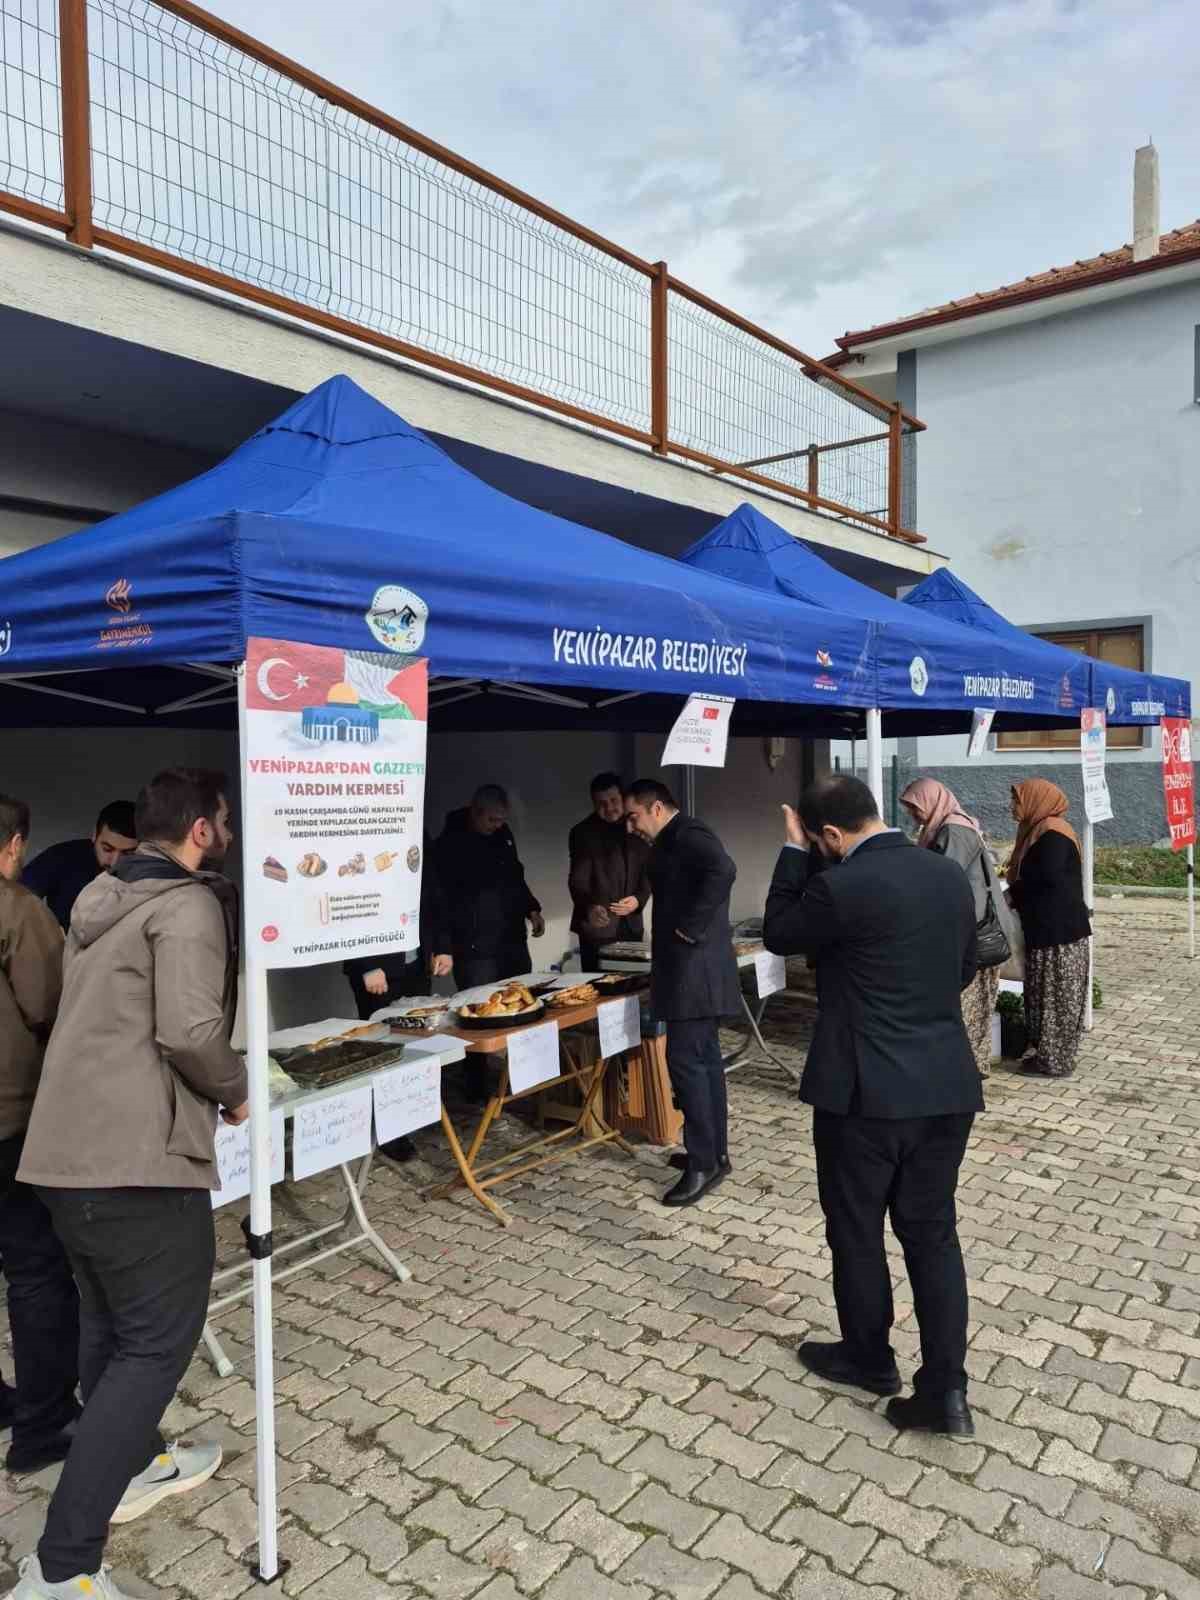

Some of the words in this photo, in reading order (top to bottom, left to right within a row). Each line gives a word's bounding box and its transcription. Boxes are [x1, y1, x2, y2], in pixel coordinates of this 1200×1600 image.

[553, 625, 657, 671] YENİPAZAR
[662, 638, 747, 677] BELEDİYESİ
[963, 673, 1000, 698] YENİPAZAR
[1001, 675, 1034, 699] BELEDİYESİ
[249, 756, 370, 774] YENİPAZAR'DAN
[287, 783, 344, 796] YARDIM
[346, 780, 404, 796] KERMESİ
[284, 808, 307, 816] KASIM
[309, 807, 348, 816] ÇARŞAMBA
[349, 806, 370, 814] GÜNÜ
[287, 818, 318, 827] YERİNDE
[320, 818, 358, 826] YAPILACAK
[359, 817, 377, 825] OLAN
[293, 941, 339, 955] YENİPAZAR
[341, 938, 356, 949] İLÇE
[358, 930, 406, 946] MÜFTÜLÜĞÜ
